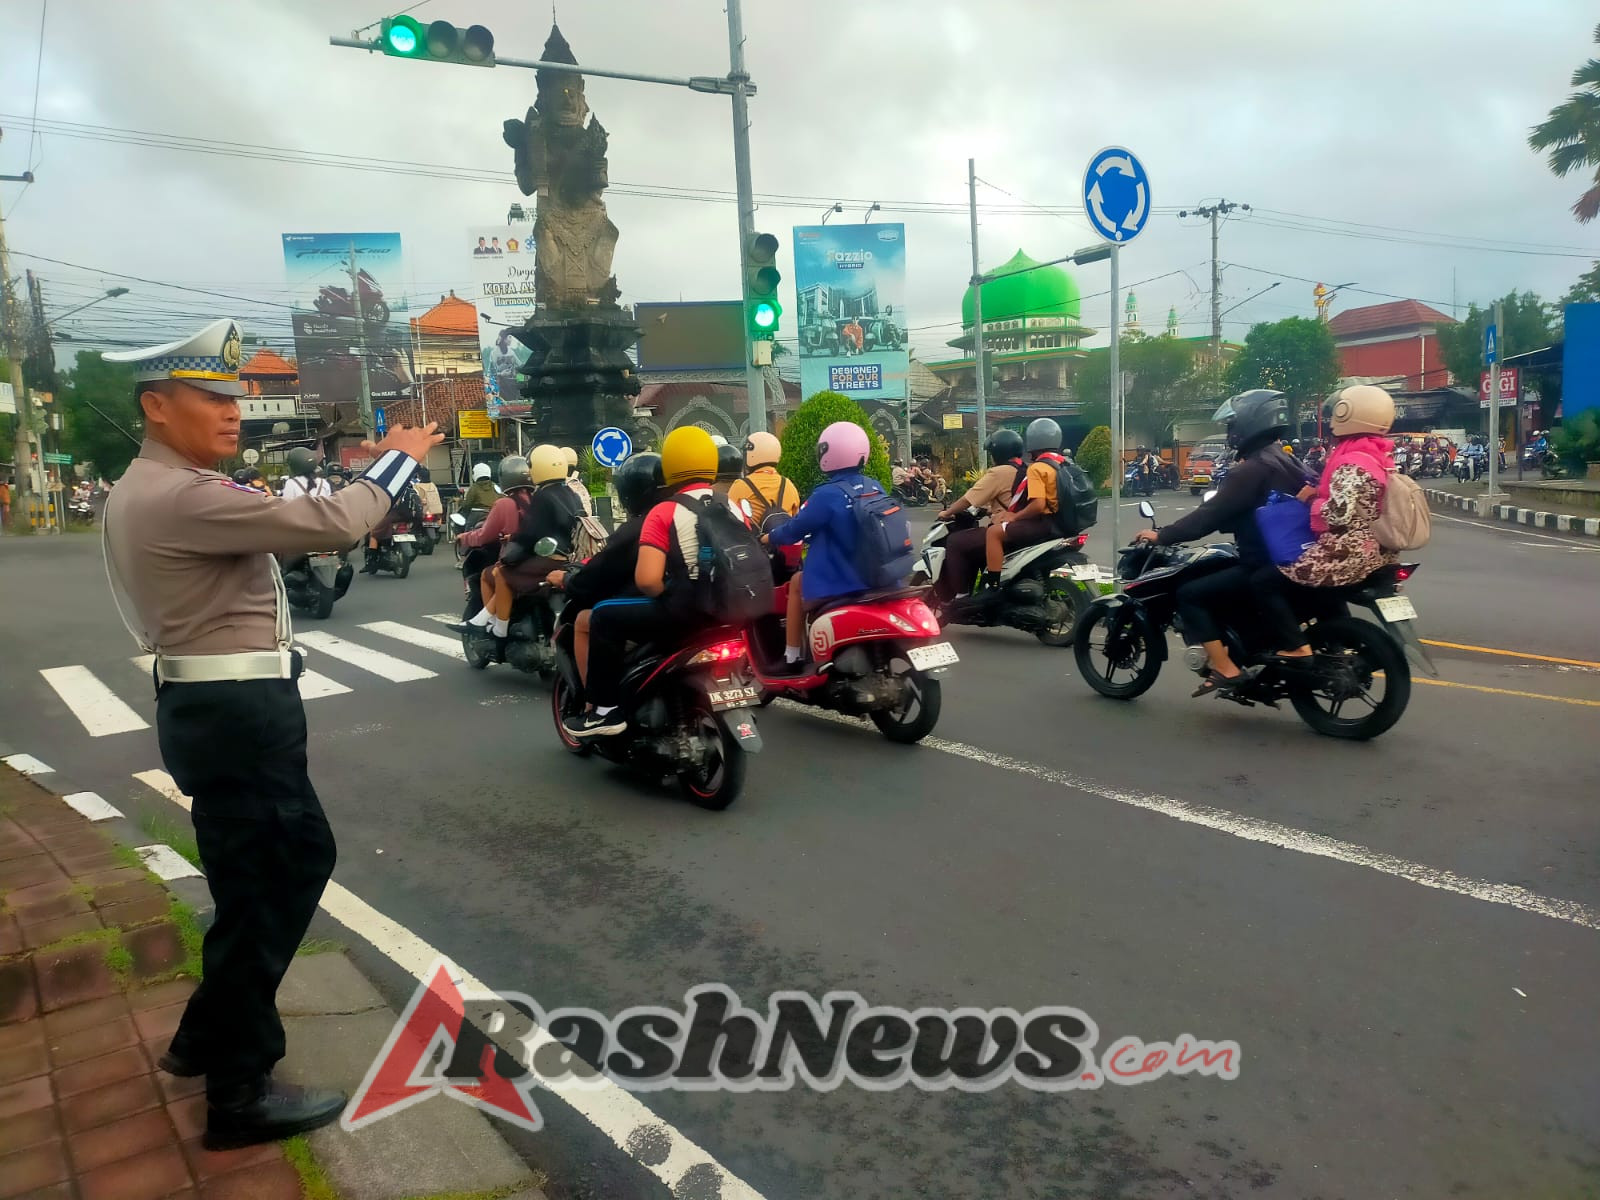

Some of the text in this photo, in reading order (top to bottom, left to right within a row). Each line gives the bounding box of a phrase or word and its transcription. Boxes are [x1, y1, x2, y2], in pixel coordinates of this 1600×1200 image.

[484, 282, 516, 295] KOTA
[495, 297, 531, 306] Harmony
[831, 366, 879, 375] DESIGNED
[832, 374, 853, 382] FOR
[857, 373, 879, 381] OUR
[832, 380, 879, 390] STREETS
[1482, 376, 1515, 394] GGI
[723, 689, 744, 700] 3273
